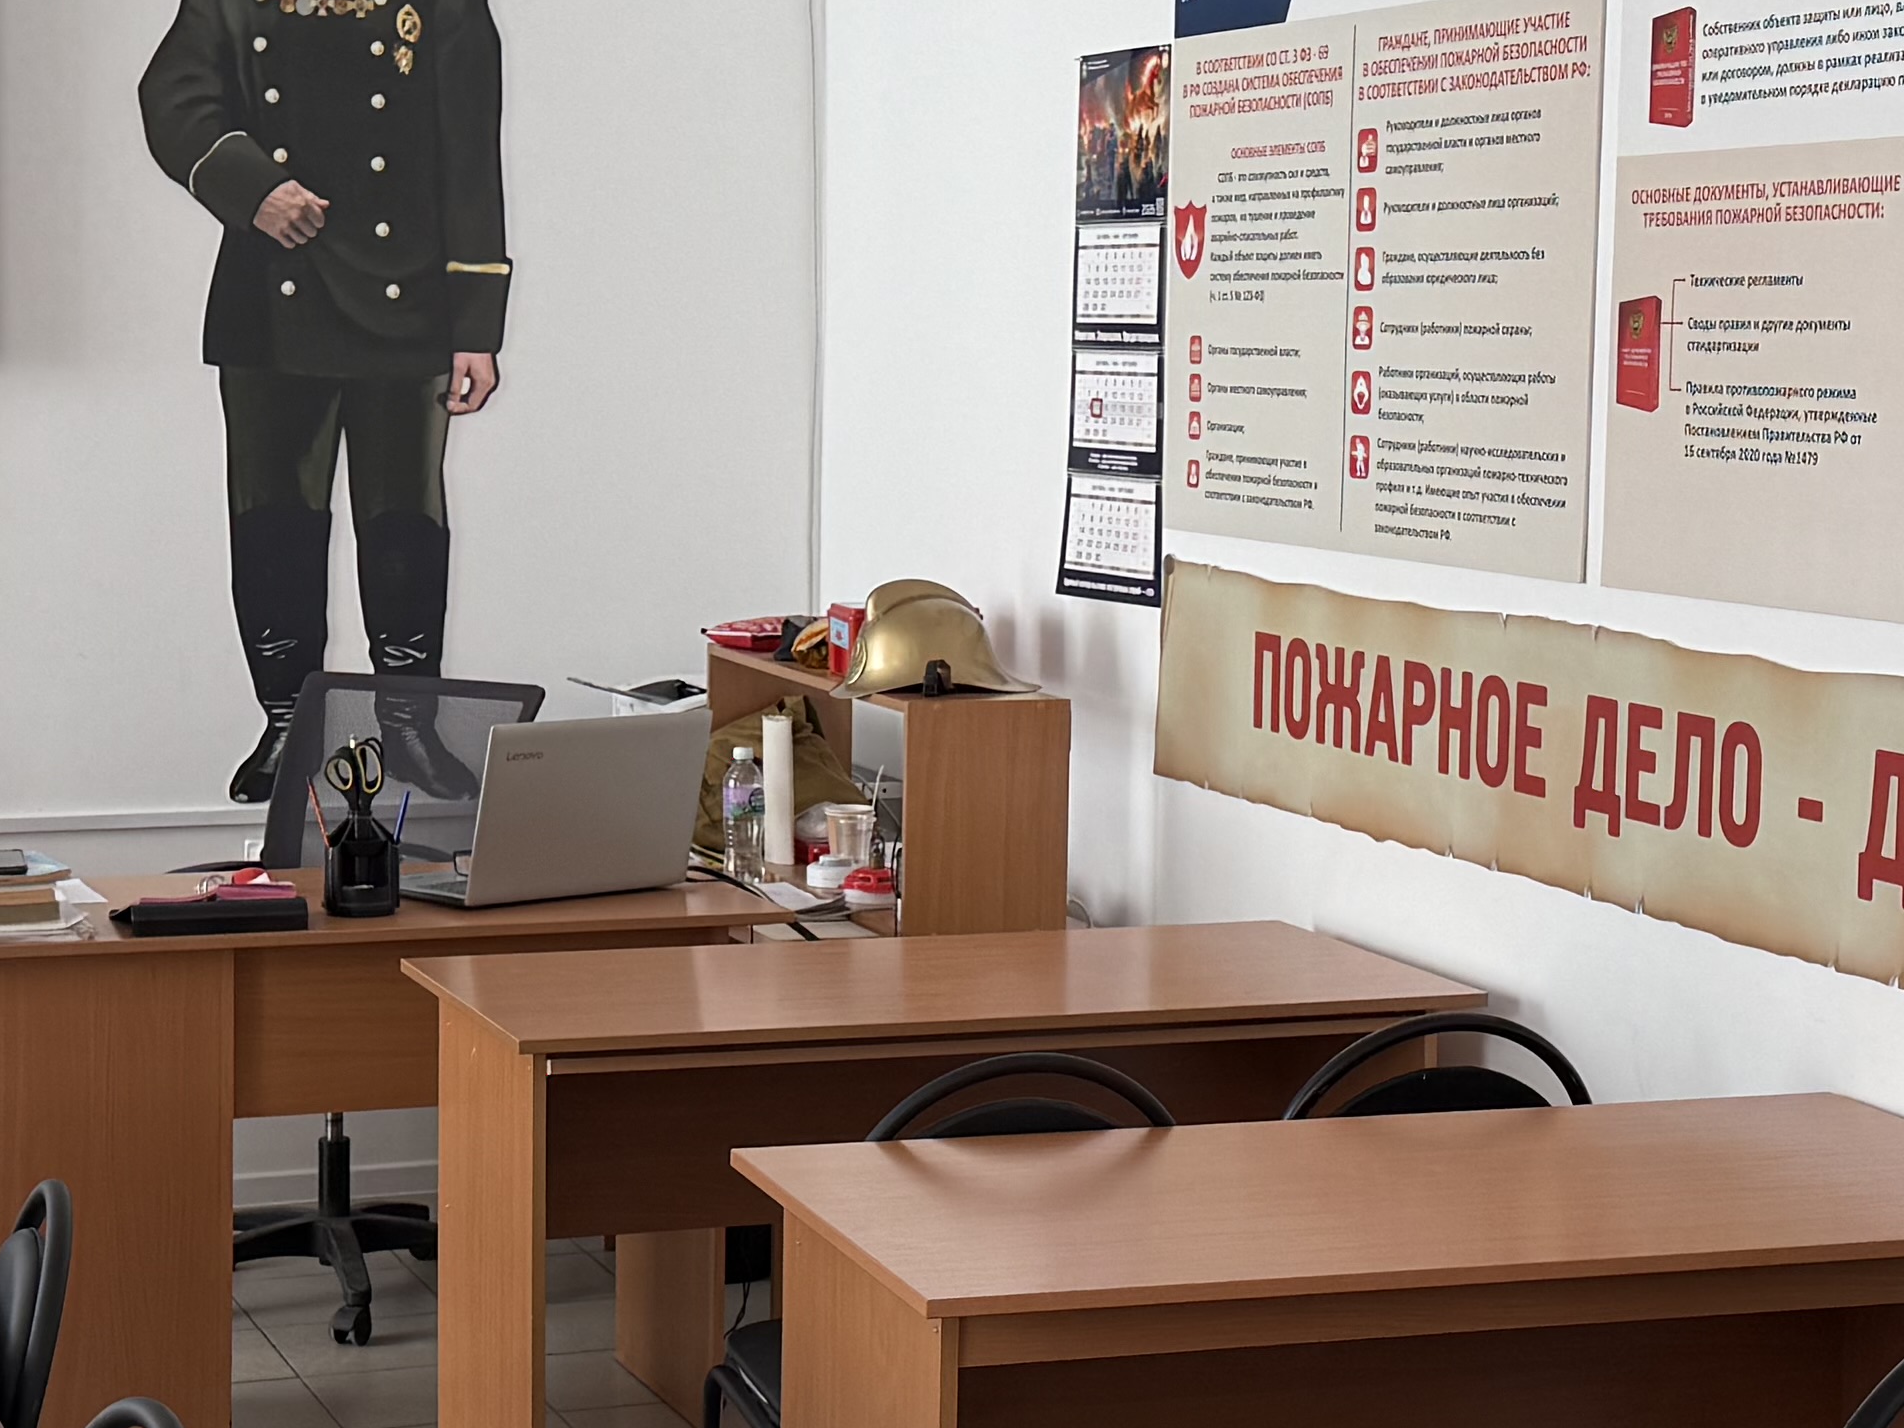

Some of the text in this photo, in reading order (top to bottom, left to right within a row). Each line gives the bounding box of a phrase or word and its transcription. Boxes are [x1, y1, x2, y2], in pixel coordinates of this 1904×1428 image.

[1379, 11, 1571, 52] ГРАЖДАНЕ, ПРИНИМАЮЩИЕ УЧАСТИЕ
[1363, 35, 1587, 78] В ОБЕСПЕЧЕНИИ ПОЖАРНОЙ БЕЗОПАСНОСТИ
[1367, 78, 1439, 100] СООТВЕТСТВИИ
[1449, 63, 1569, 92] ЗАКОНОДАТЕЛЬСТВОМ
[1571, 61, 1591, 79] РФ:
[1632, 175, 1902, 205] ОСНОВНЫЕ ДОКУМЕНТЫ, УСТАНАВЛИВАЮЩИЕ
[1643, 202, 1884, 229] ТРЕБОВАНИЯ ПОЖАРНОЙ БЕЗОПАСНОСТИ:
[506, 751, 544, 762] Lenovo
[1254, 631, 1548, 800] ПОЖАРНОЕ
[1573, 695, 1763, 848] ДЕЛО
